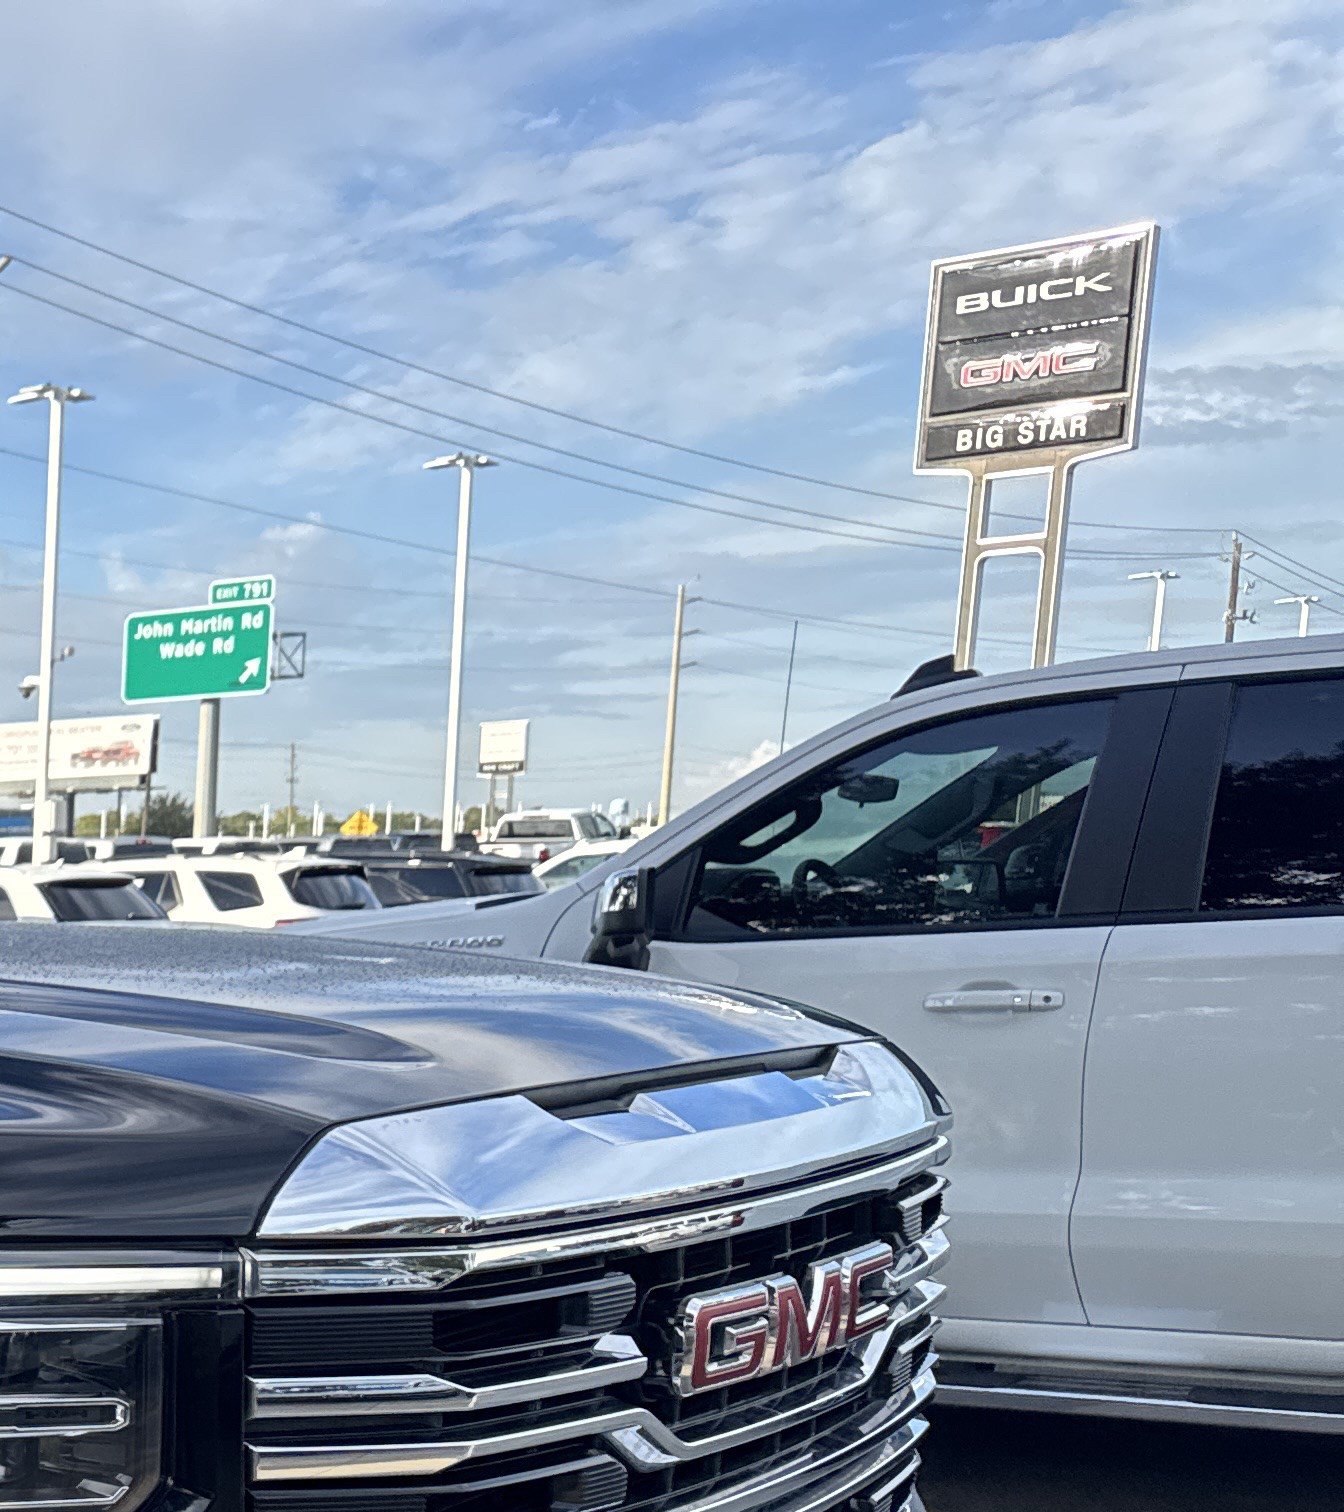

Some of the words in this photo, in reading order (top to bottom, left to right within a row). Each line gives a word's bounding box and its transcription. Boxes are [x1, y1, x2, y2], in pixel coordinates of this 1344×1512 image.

[955, 271, 1113, 315] BUICK
[959, 340, 1101, 388] GMC
[955, 425, 1004, 452] BIG
[1016, 415, 1088, 446] STAR
[215, 586, 239, 601] EXIT
[243, 581, 269, 600] 791
[133, 620, 174, 641] John
[180, 613, 234, 636] Martin
[241, 610, 265, 631] Rd
[159, 637, 206, 660] Wade
[212, 635, 236, 655] Rd
[673, 1239, 894, 1398] GMC
